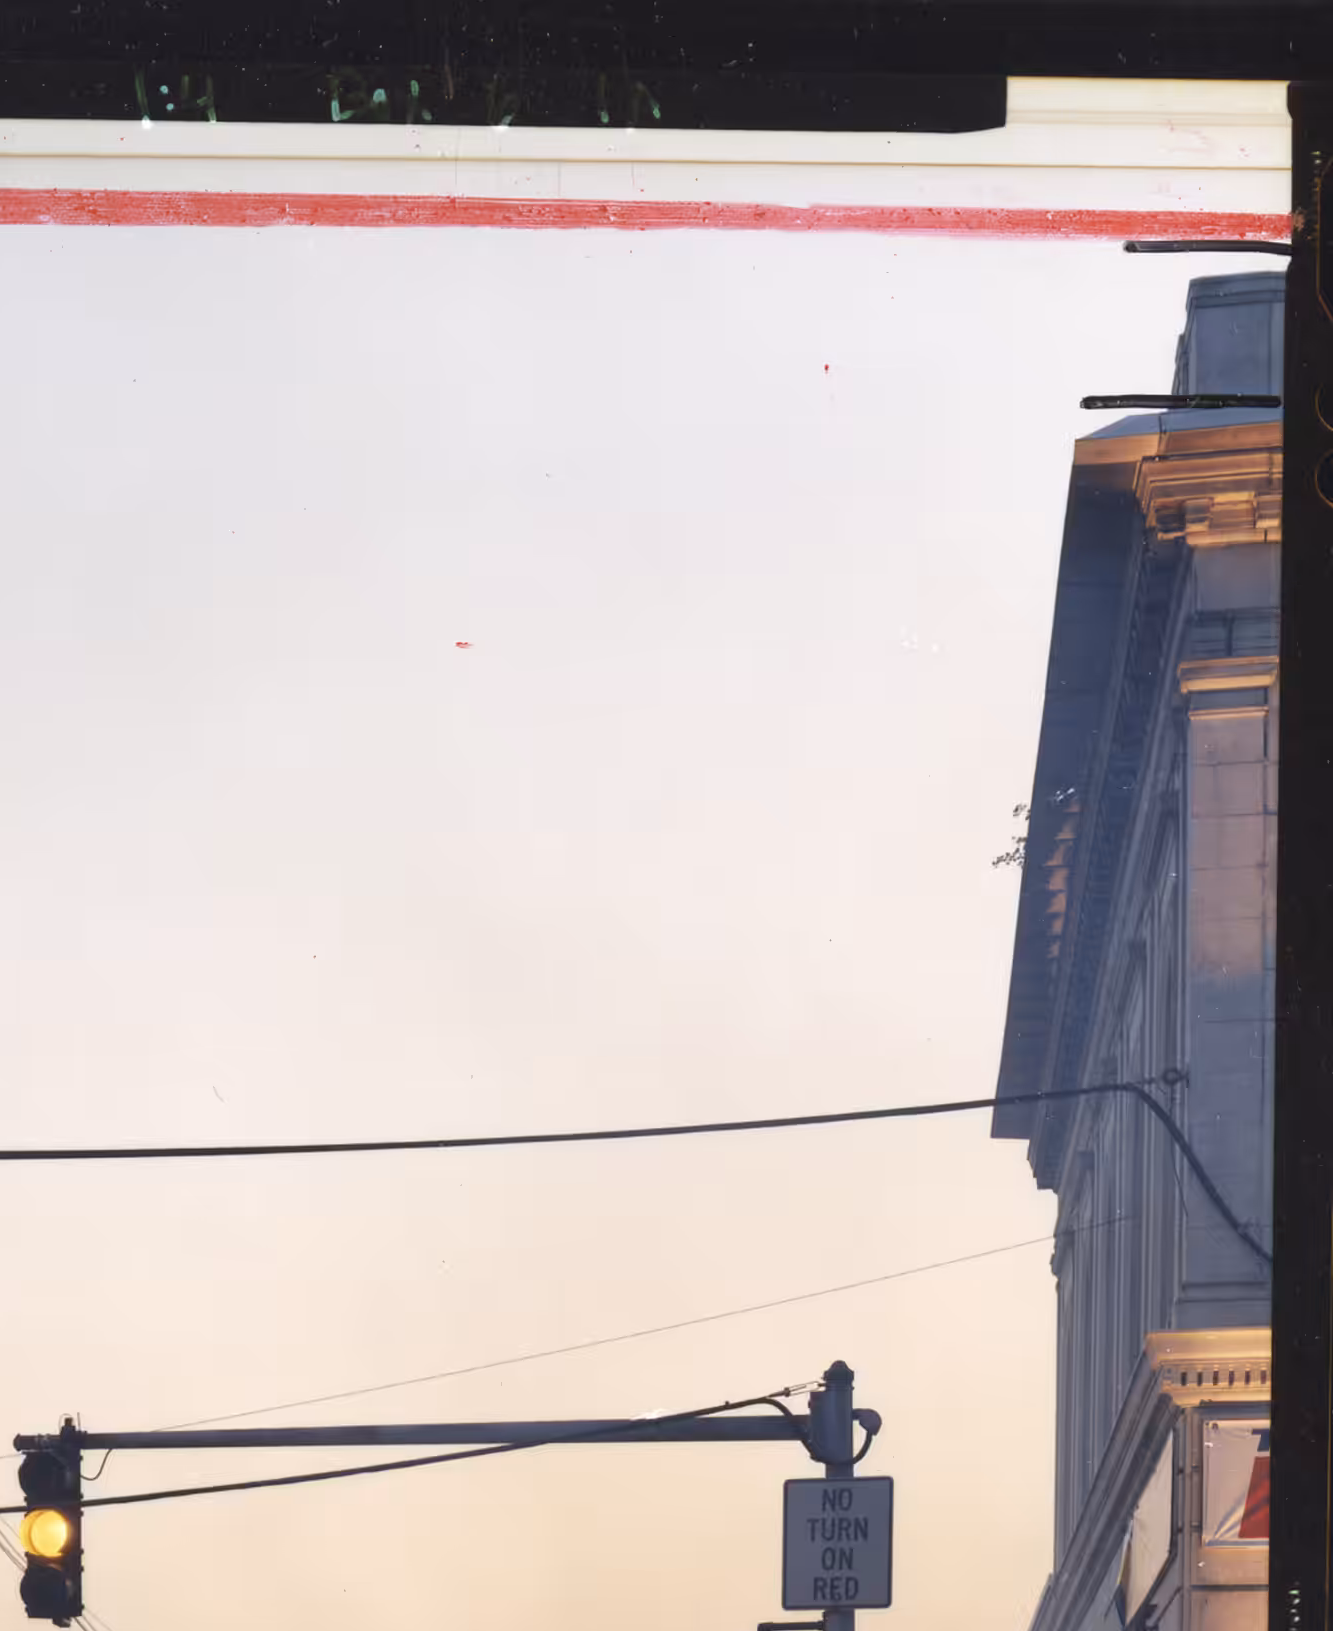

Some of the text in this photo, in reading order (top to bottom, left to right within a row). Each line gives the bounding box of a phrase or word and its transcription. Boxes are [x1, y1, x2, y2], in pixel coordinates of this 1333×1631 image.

[821, 1488, 853, 1512] NO
[806, 1517, 869, 1542] TURN
[821, 1547, 854, 1571] ON
[812, 1576, 859, 1601] RED
